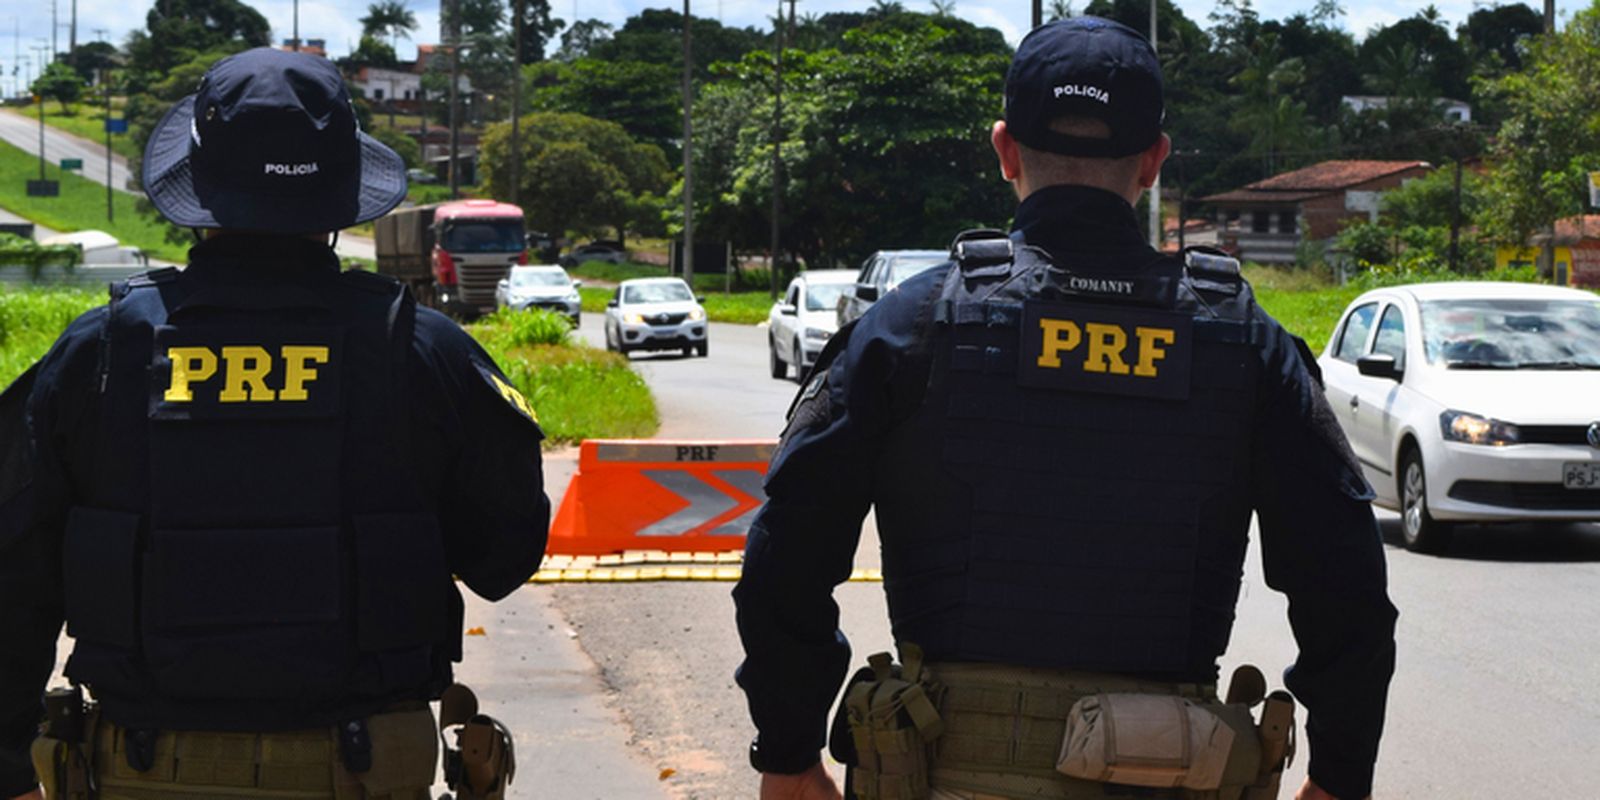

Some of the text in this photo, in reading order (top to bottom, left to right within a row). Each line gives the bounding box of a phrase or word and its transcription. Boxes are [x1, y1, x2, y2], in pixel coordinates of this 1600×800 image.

[164, 346, 329, 402] PRF
[1037, 318, 1175, 377] PRF
[675, 445, 719, 461] PRF
